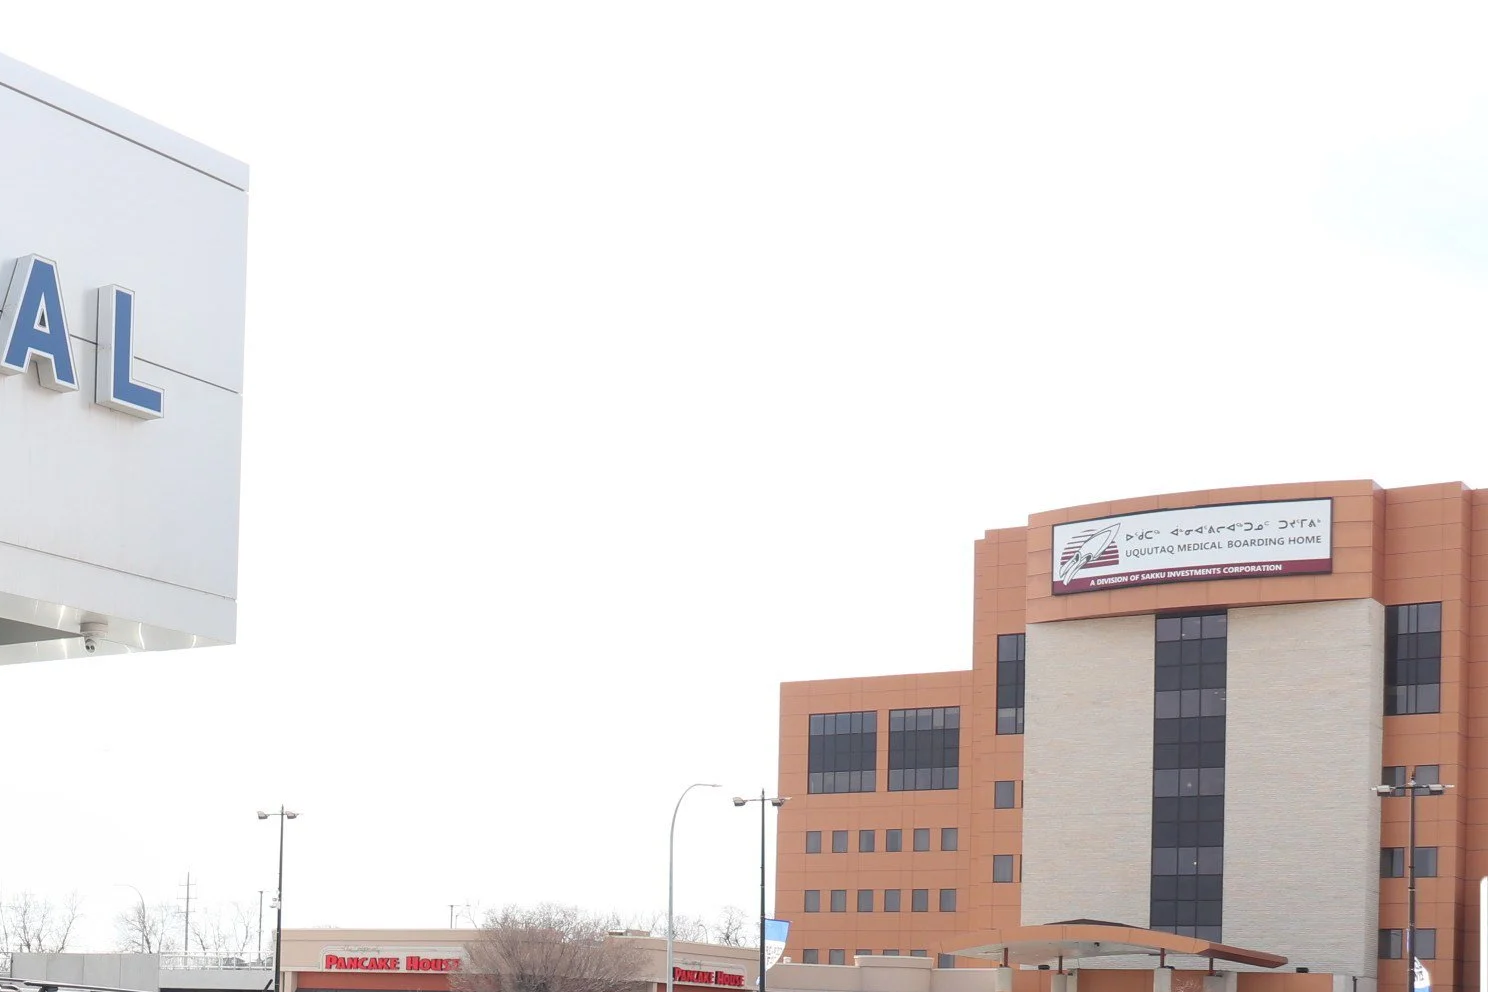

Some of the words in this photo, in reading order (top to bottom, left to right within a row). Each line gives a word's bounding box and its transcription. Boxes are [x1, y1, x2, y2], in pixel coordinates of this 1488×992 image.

[1125, 545, 1175, 558] UQUUTAQ
[1177, 541, 1223, 552] MEDICAL
[1227, 537, 1285, 548] BOARDING
[1288, 535, 1322, 545] HOME
[1096, 575, 1128, 585] DIVISION
[1129, 574, 1140, 582] OF
[1141, 571, 1166, 581] SAKKU
[1167, 567, 1222, 578] INVESTMENTS
[1222, 564, 1283, 574] CORPORATION
[325, 954, 400, 970] PANCAKE
[673, 966, 715, 984] PANCAKE
[715, 970, 745, 987] HOUSE
